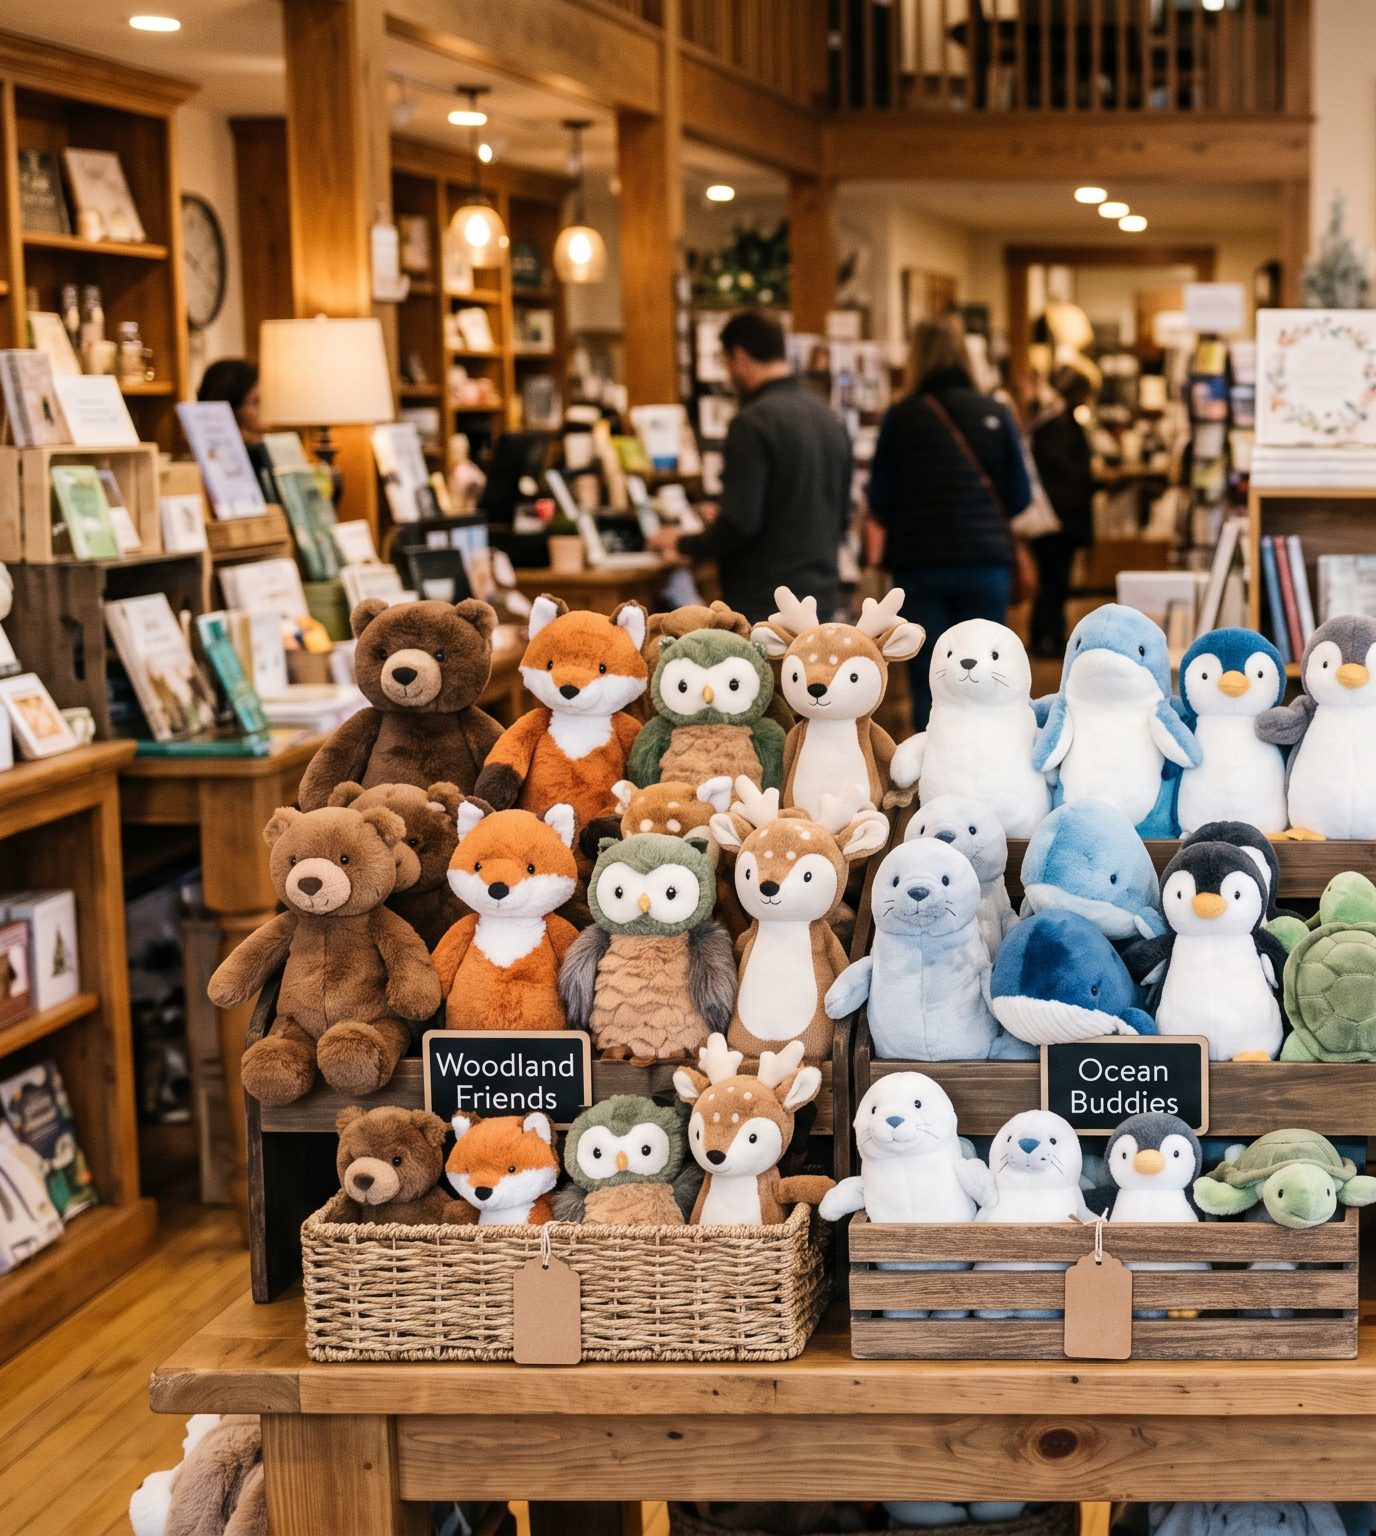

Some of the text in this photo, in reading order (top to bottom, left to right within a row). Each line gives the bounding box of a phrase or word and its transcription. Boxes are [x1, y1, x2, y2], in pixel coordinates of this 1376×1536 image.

[435, 1052, 574, 1077] Woodland
[1078, 1057, 1168, 1082] Ocean
[456, 1084, 557, 1110] Friends
[1071, 1089, 1179, 1114] Buddies
